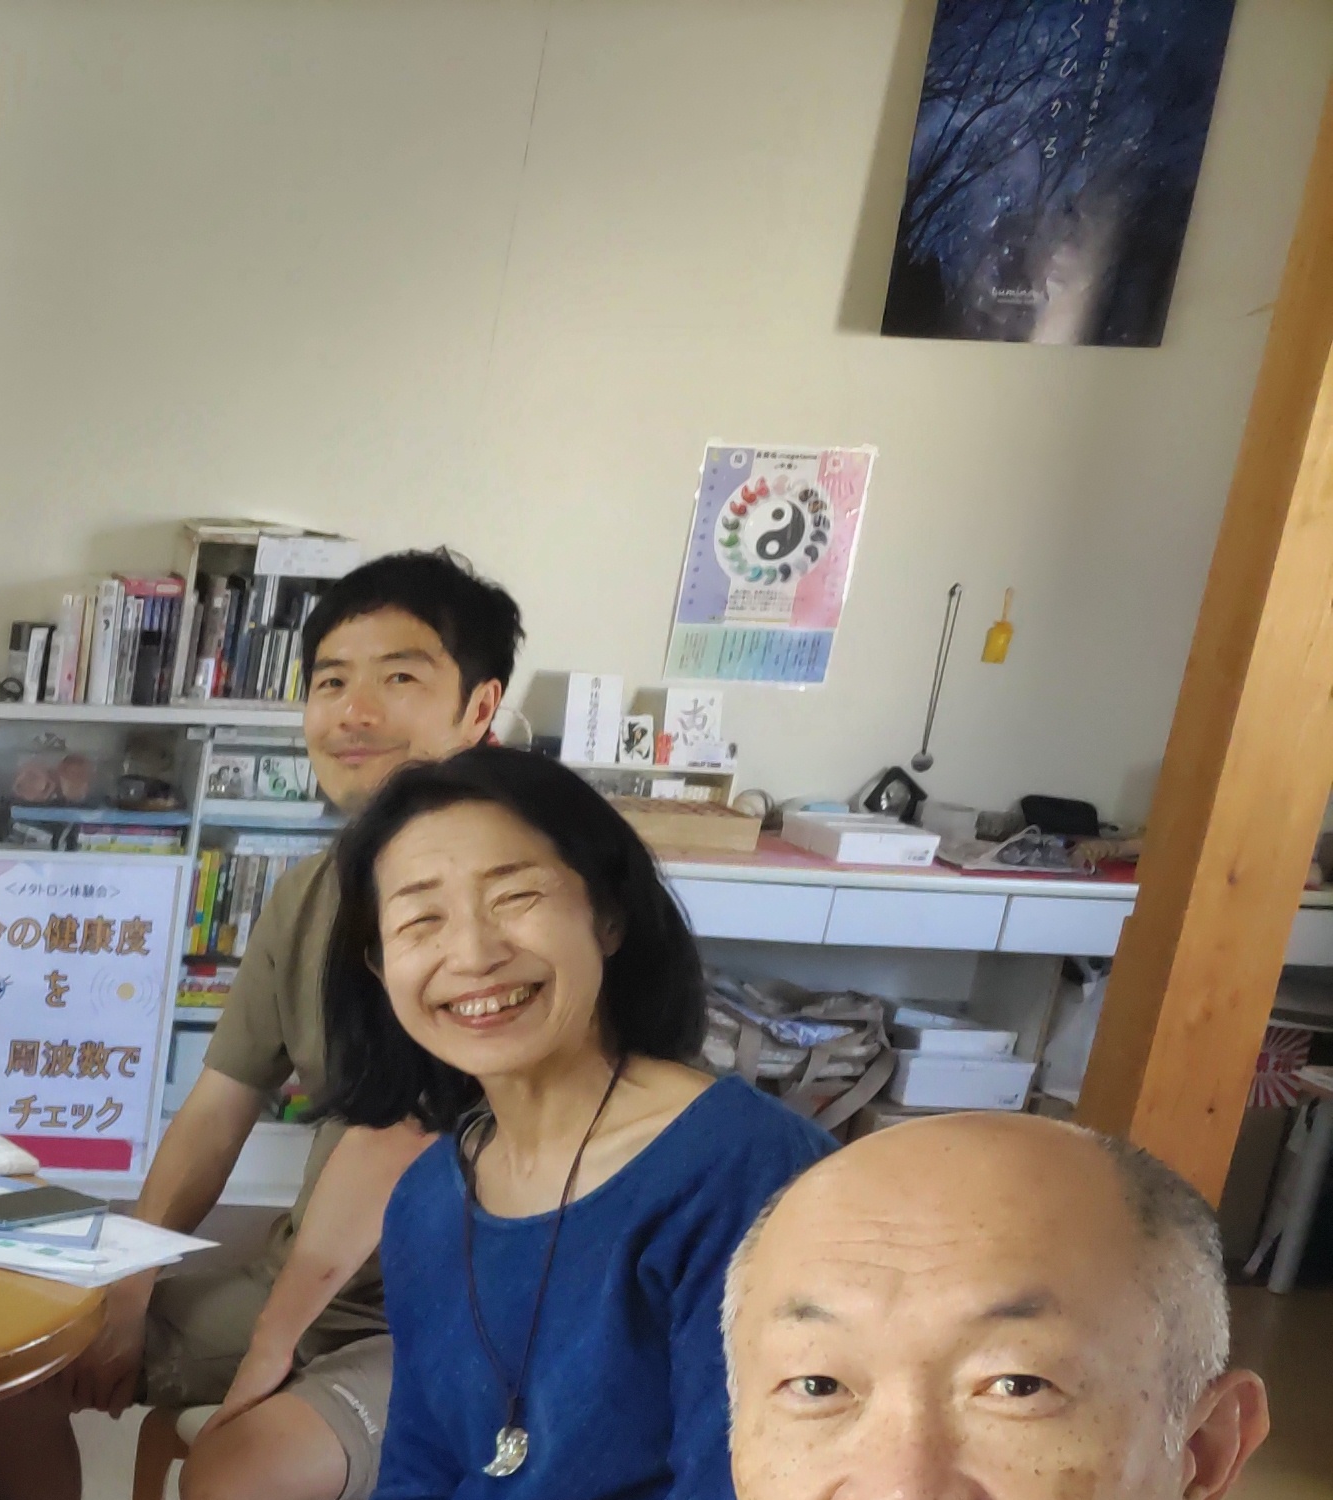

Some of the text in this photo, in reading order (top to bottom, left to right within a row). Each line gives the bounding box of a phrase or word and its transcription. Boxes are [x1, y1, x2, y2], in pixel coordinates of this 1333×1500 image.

[44, 970, 71, 1008] を
[4, 1038, 141, 1080] 周波数で
[8, 1095, 124, 1133] チェック
